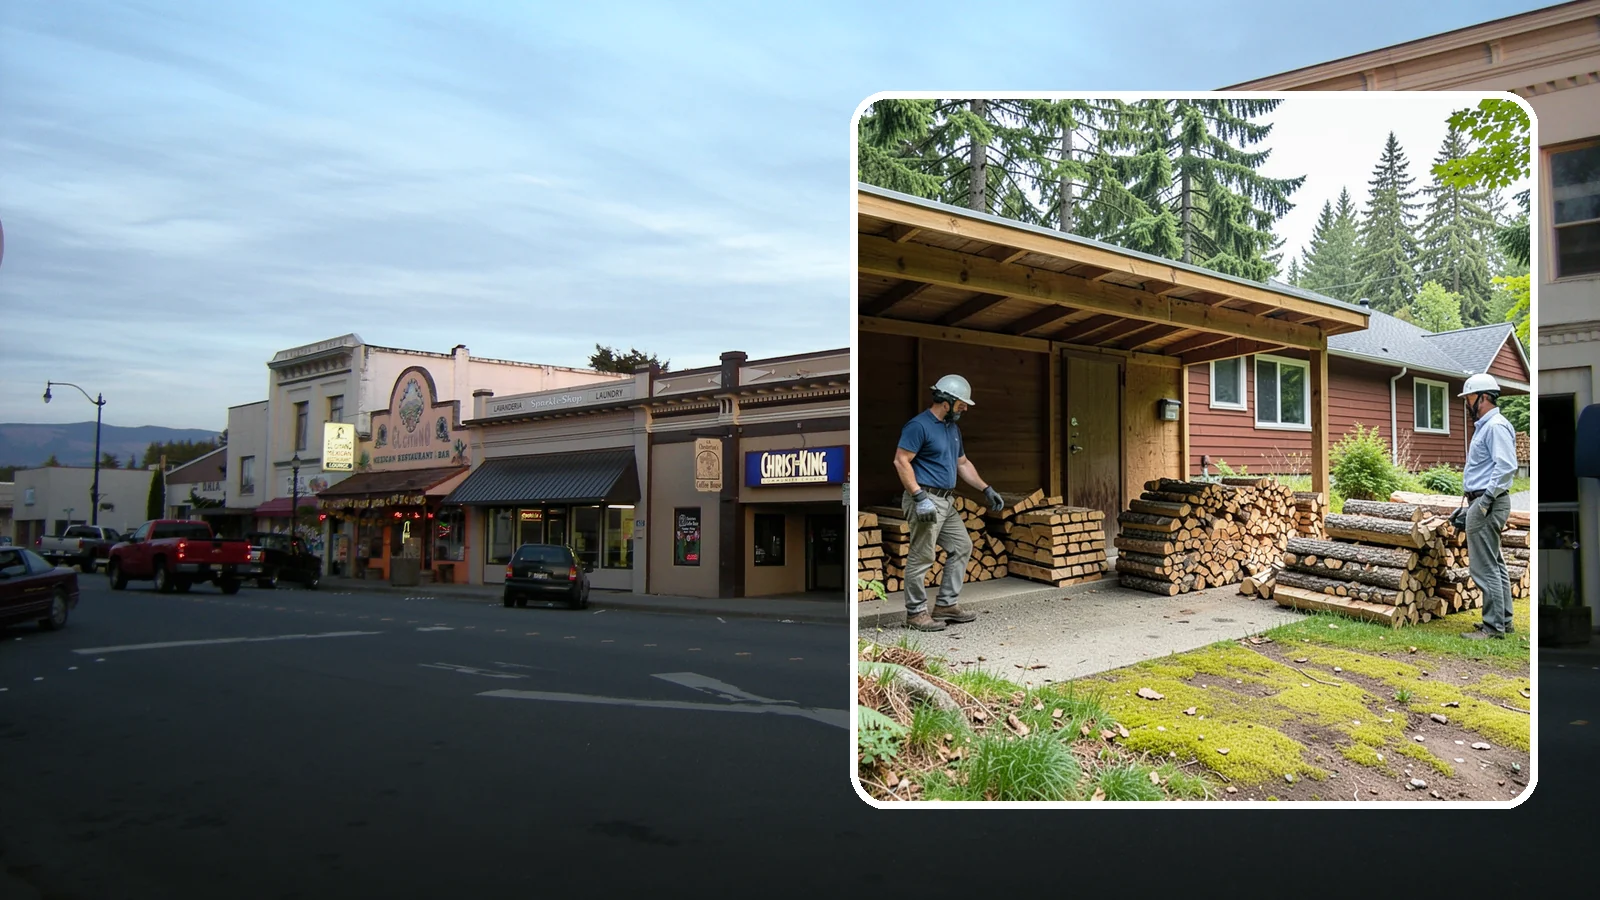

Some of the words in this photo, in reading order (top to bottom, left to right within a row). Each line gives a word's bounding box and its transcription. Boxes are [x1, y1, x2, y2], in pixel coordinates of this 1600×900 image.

[493, 402, 522, 412] LAVANDERIA
[595, 389, 623, 399] LAUNDRY
[374, 455, 396, 464] MEXICAN
[397, 451, 433, 462] RESTAURANT
[437, 450, 450, 459] BAR
[761, 452, 797, 478] CHRIST
[799, 450, 827, 476] KING
